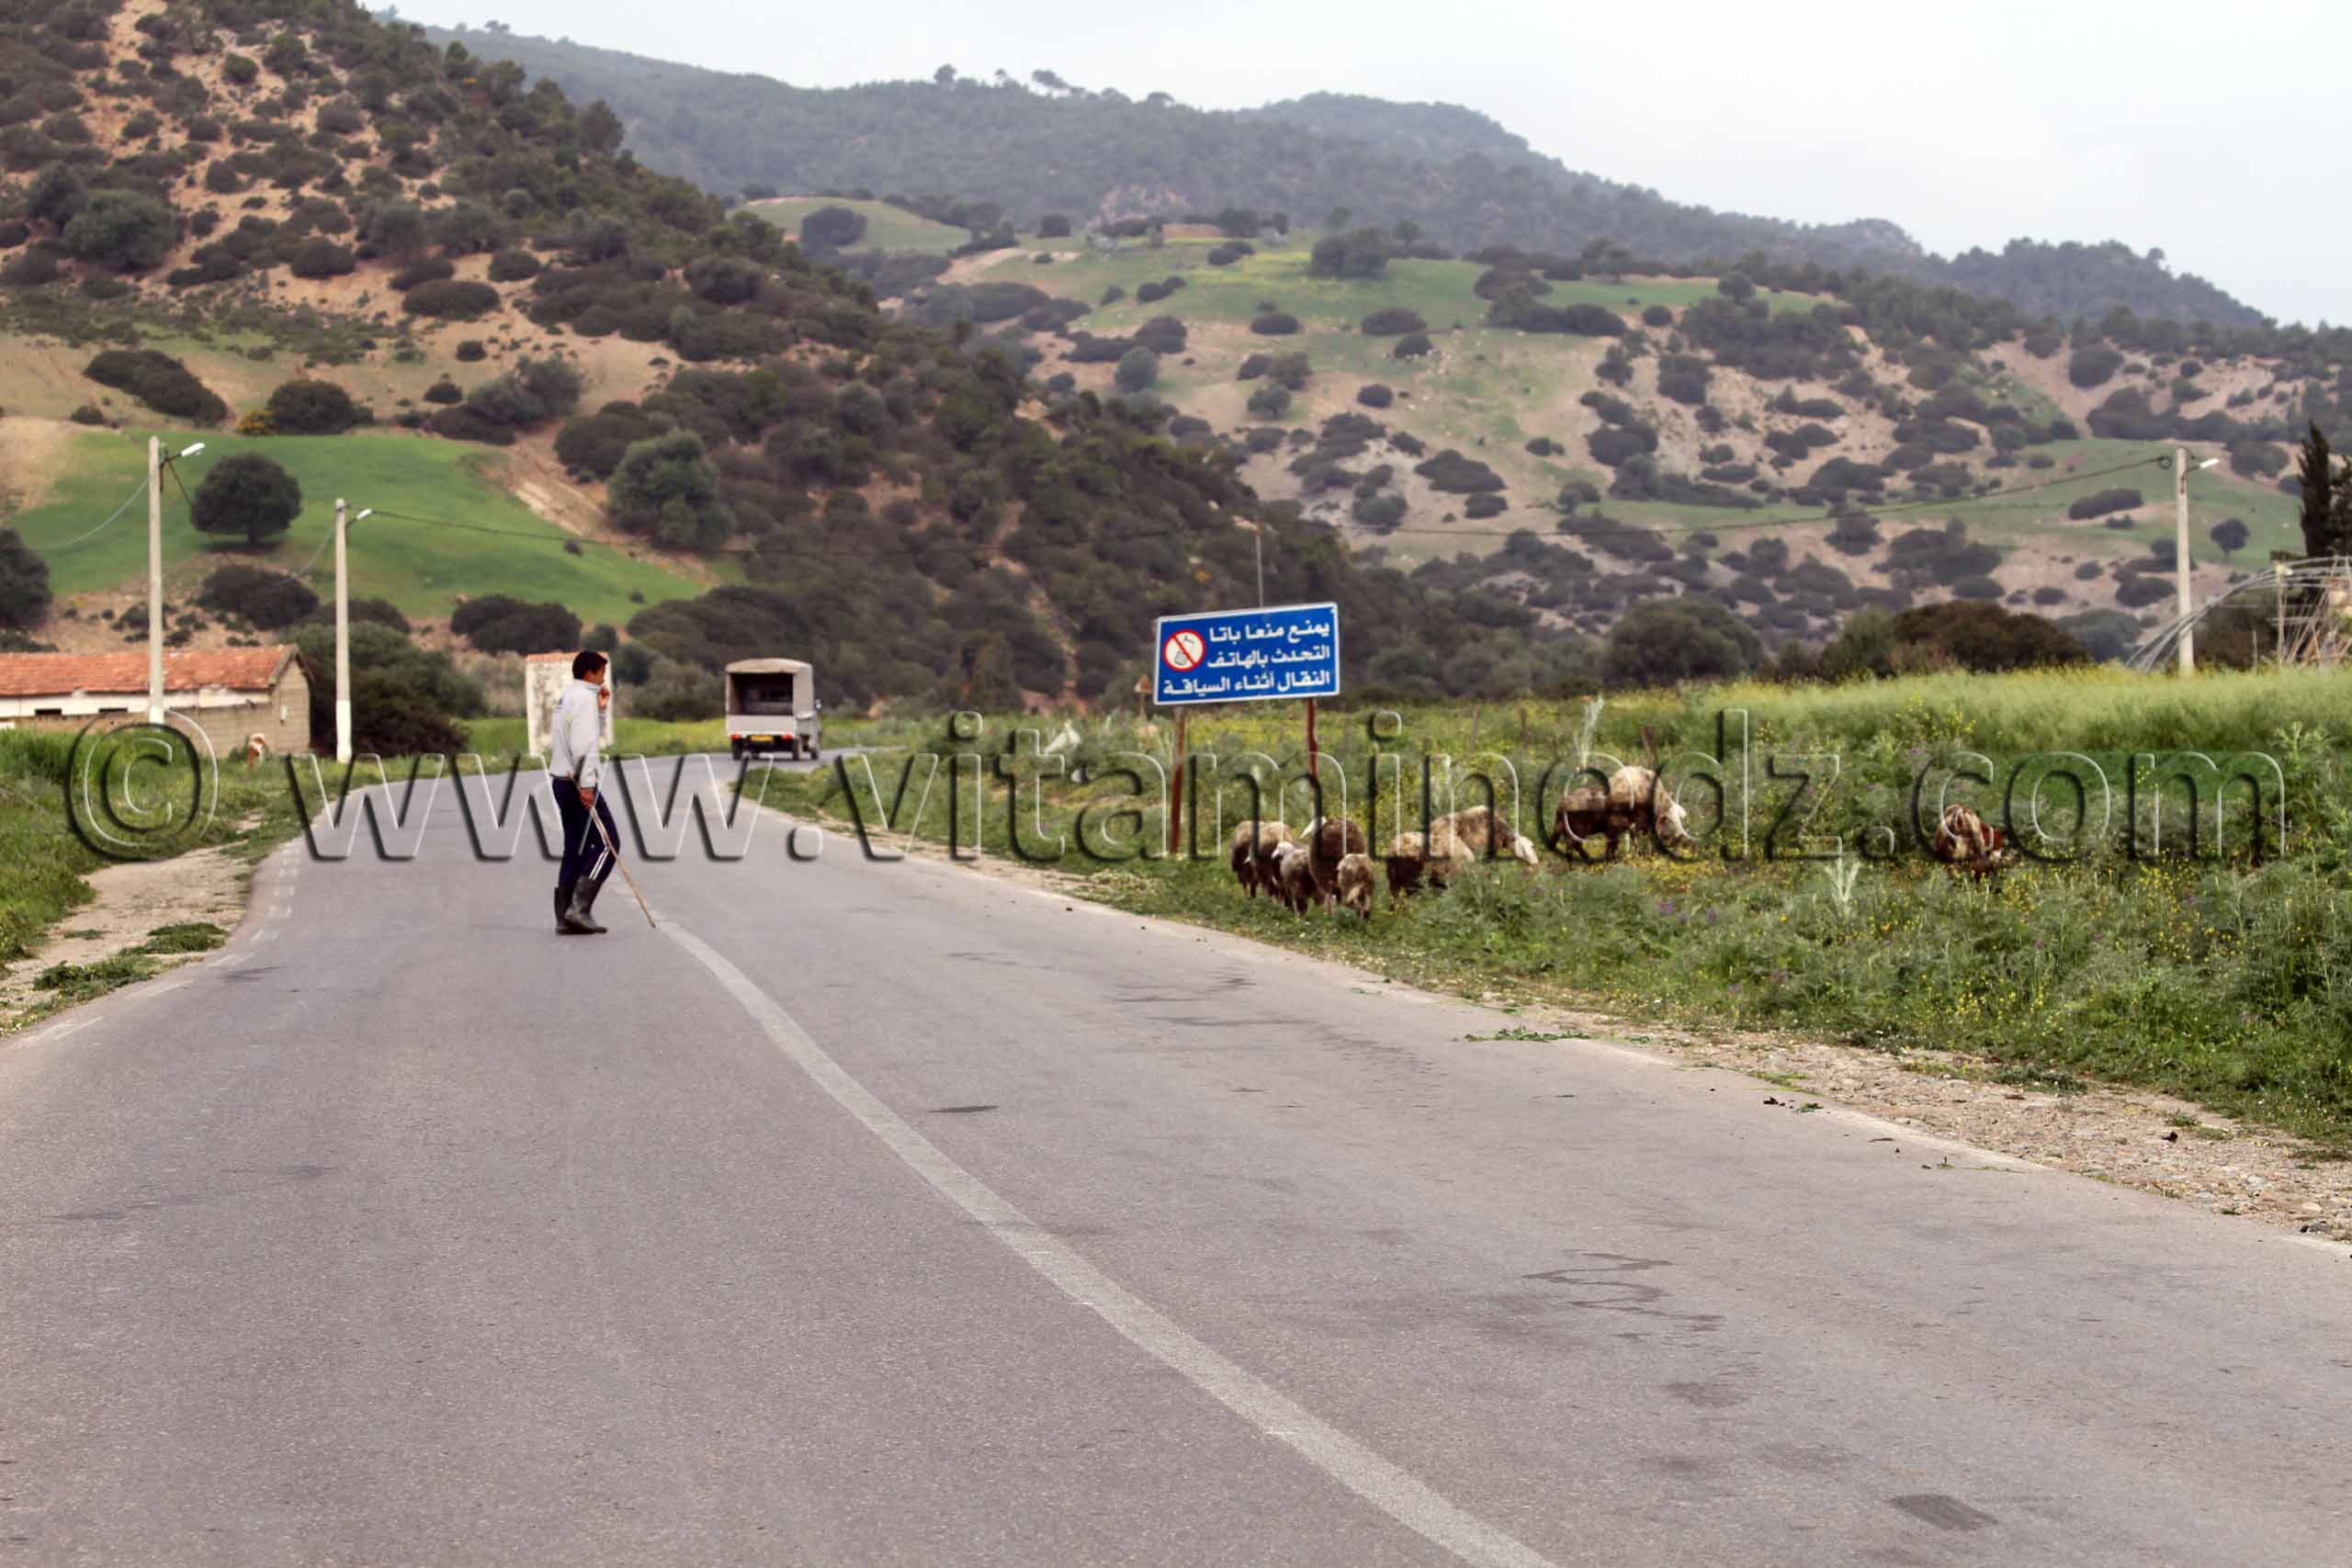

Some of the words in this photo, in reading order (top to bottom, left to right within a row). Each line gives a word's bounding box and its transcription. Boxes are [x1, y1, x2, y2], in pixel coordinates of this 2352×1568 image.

[1209, 626, 1240, 645] باتا
[1288, 620, 1329, 644] يمنع
[1206, 649, 1269, 669] بالهاتف
[1272, 645, 1329, 664] التحدث
[1163, 676, 1230, 697] السياقة
[1277, 670, 1329, 692] النقال
